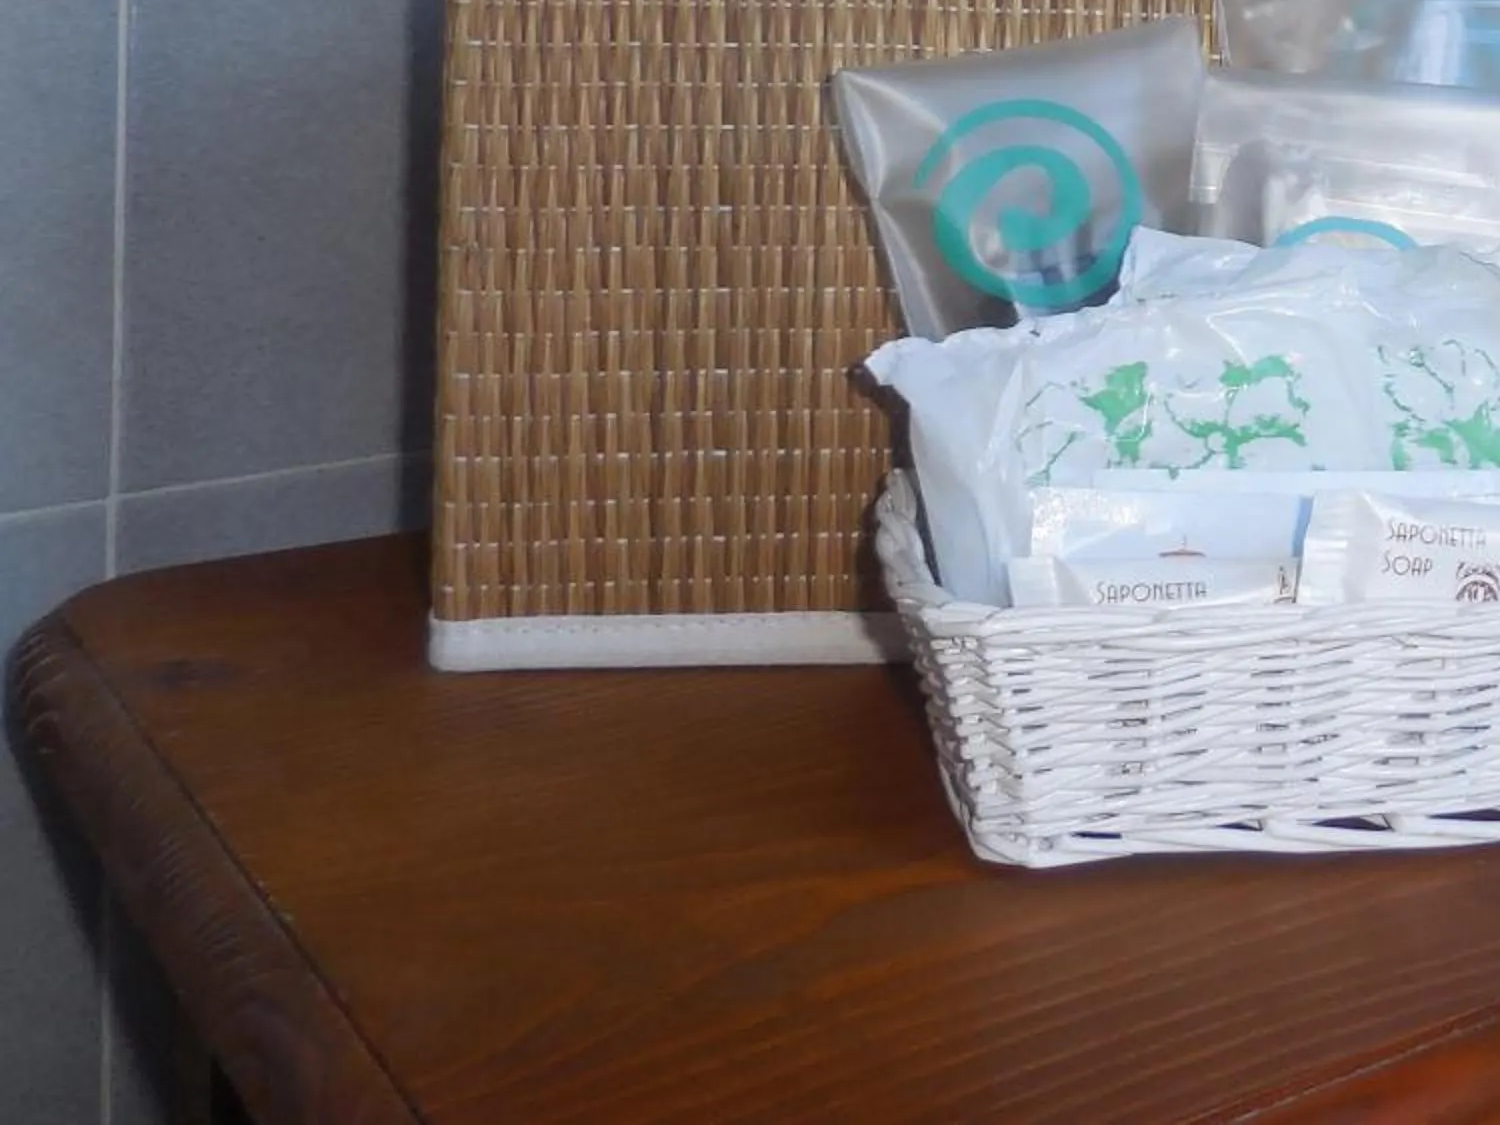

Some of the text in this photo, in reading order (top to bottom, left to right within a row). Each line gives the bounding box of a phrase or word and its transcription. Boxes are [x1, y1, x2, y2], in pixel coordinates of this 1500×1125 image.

[1386, 519, 1486, 549] SAPONETTA
[1381, 550, 1433, 577] SOAP
[1096, 581, 1207, 604] SAPONETTA
